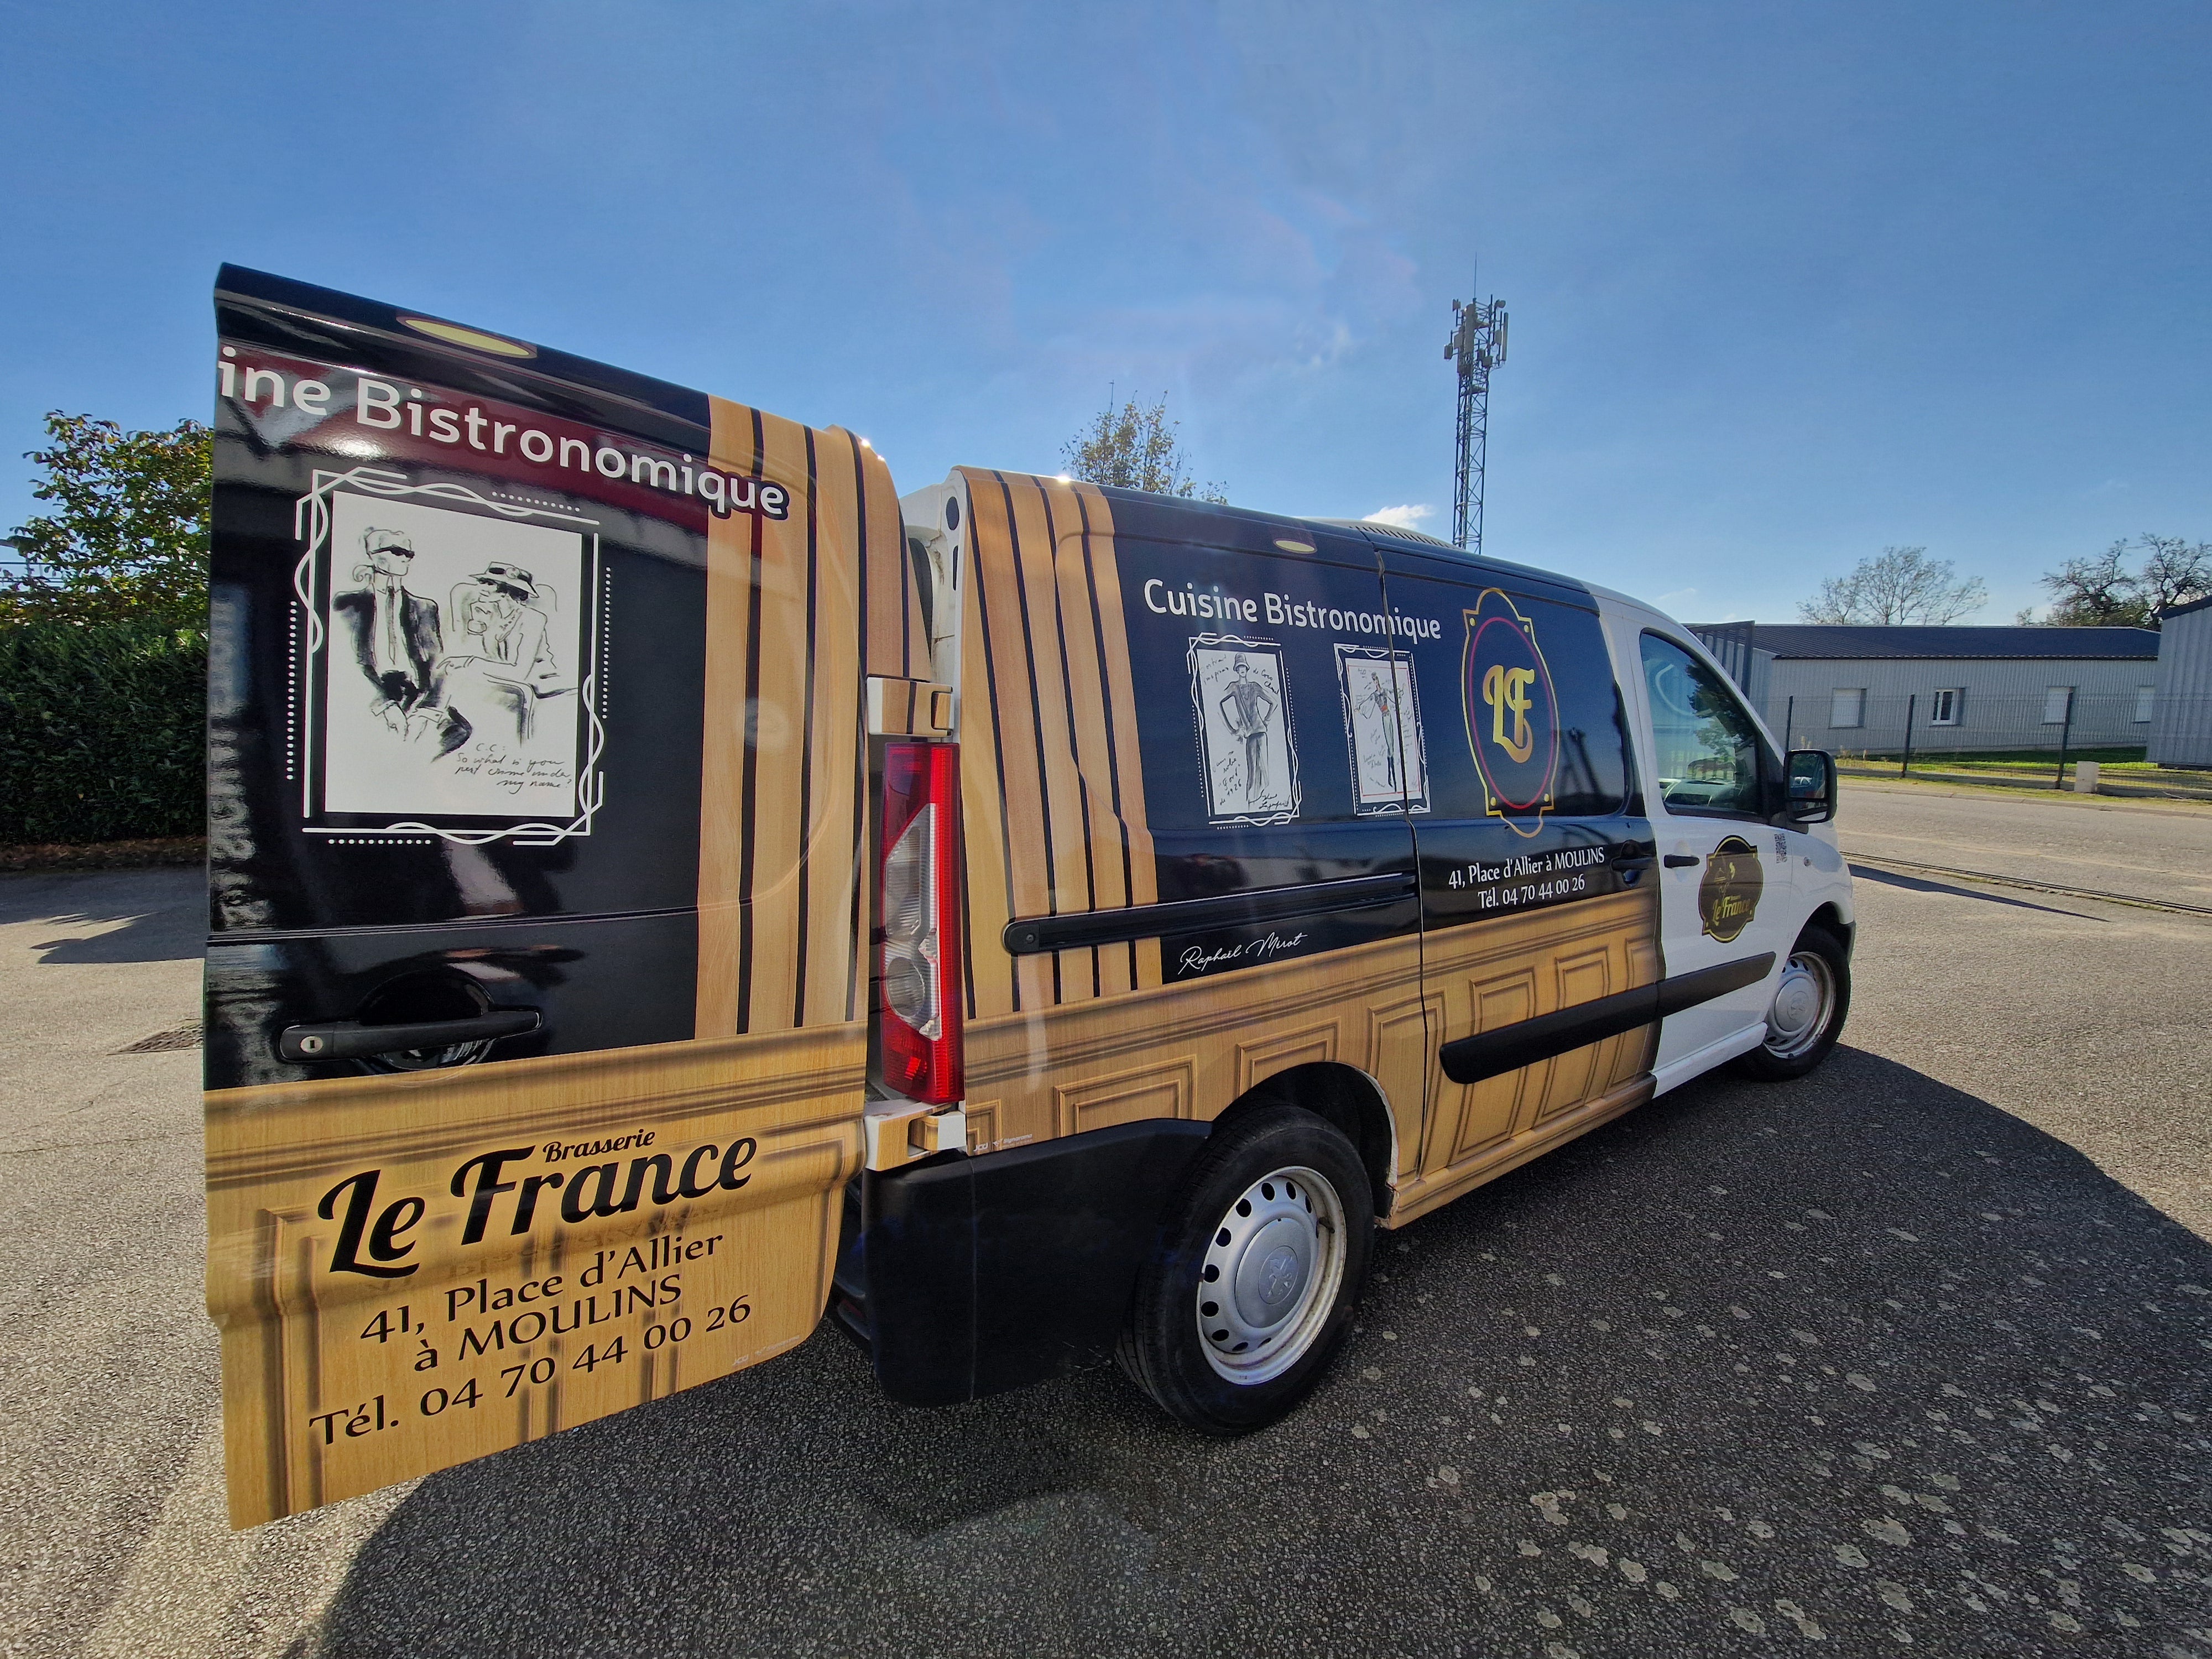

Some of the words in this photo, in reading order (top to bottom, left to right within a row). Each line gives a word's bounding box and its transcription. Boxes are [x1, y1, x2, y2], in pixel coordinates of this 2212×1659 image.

[357, 378, 784, 515] Bistronomique
[1144, 578, 1257, 622] Cuisine
[1264, 592, 1441, 645] Bistronomique
[457, 753, 468, 763] So
[1227, 779, 1241, 796] 1926
[1448, 870, 1465, 889] 41,
[1468, 862, 1500, 884] Place
[1503, 855, 1543, 878] d'Allier
[1546, 855, 1552, 872] à
[1554, 847, 1604, 870] MOULINS
[1478, 886, 1499, 909] Tél.
[1502, 888, 1518, 906] 04
[1521, 885, 1535, 903] 70
[1538, 881, 1553, 900] 44
[1556, 878, 1569, 895] 00
[1572, 873, 1585, 891] 26
[542, 1129, 656, 1162] Brasserie
[317, 1169, 425, 1278] Le
[451, 1137, 757, 1246] France
[360, 1306, 424, 1343] 41,
[445, 1278, 563, 1322] Place
[580, 1234, 723, 1287] d'Allier
[414, 1339, 438, 1371] à
[458, 1274, 681, 1361] MOULINS
[309, 1394, 399, 1445] Tél.
[420, 1378, 483, 1416] 04
[500, 1357, 556, 1398] 70
[572, 1335, 628, 1373] 44
[644, 1317, 691, 1349] 00
[706, 1294, 750, 1332] 26
